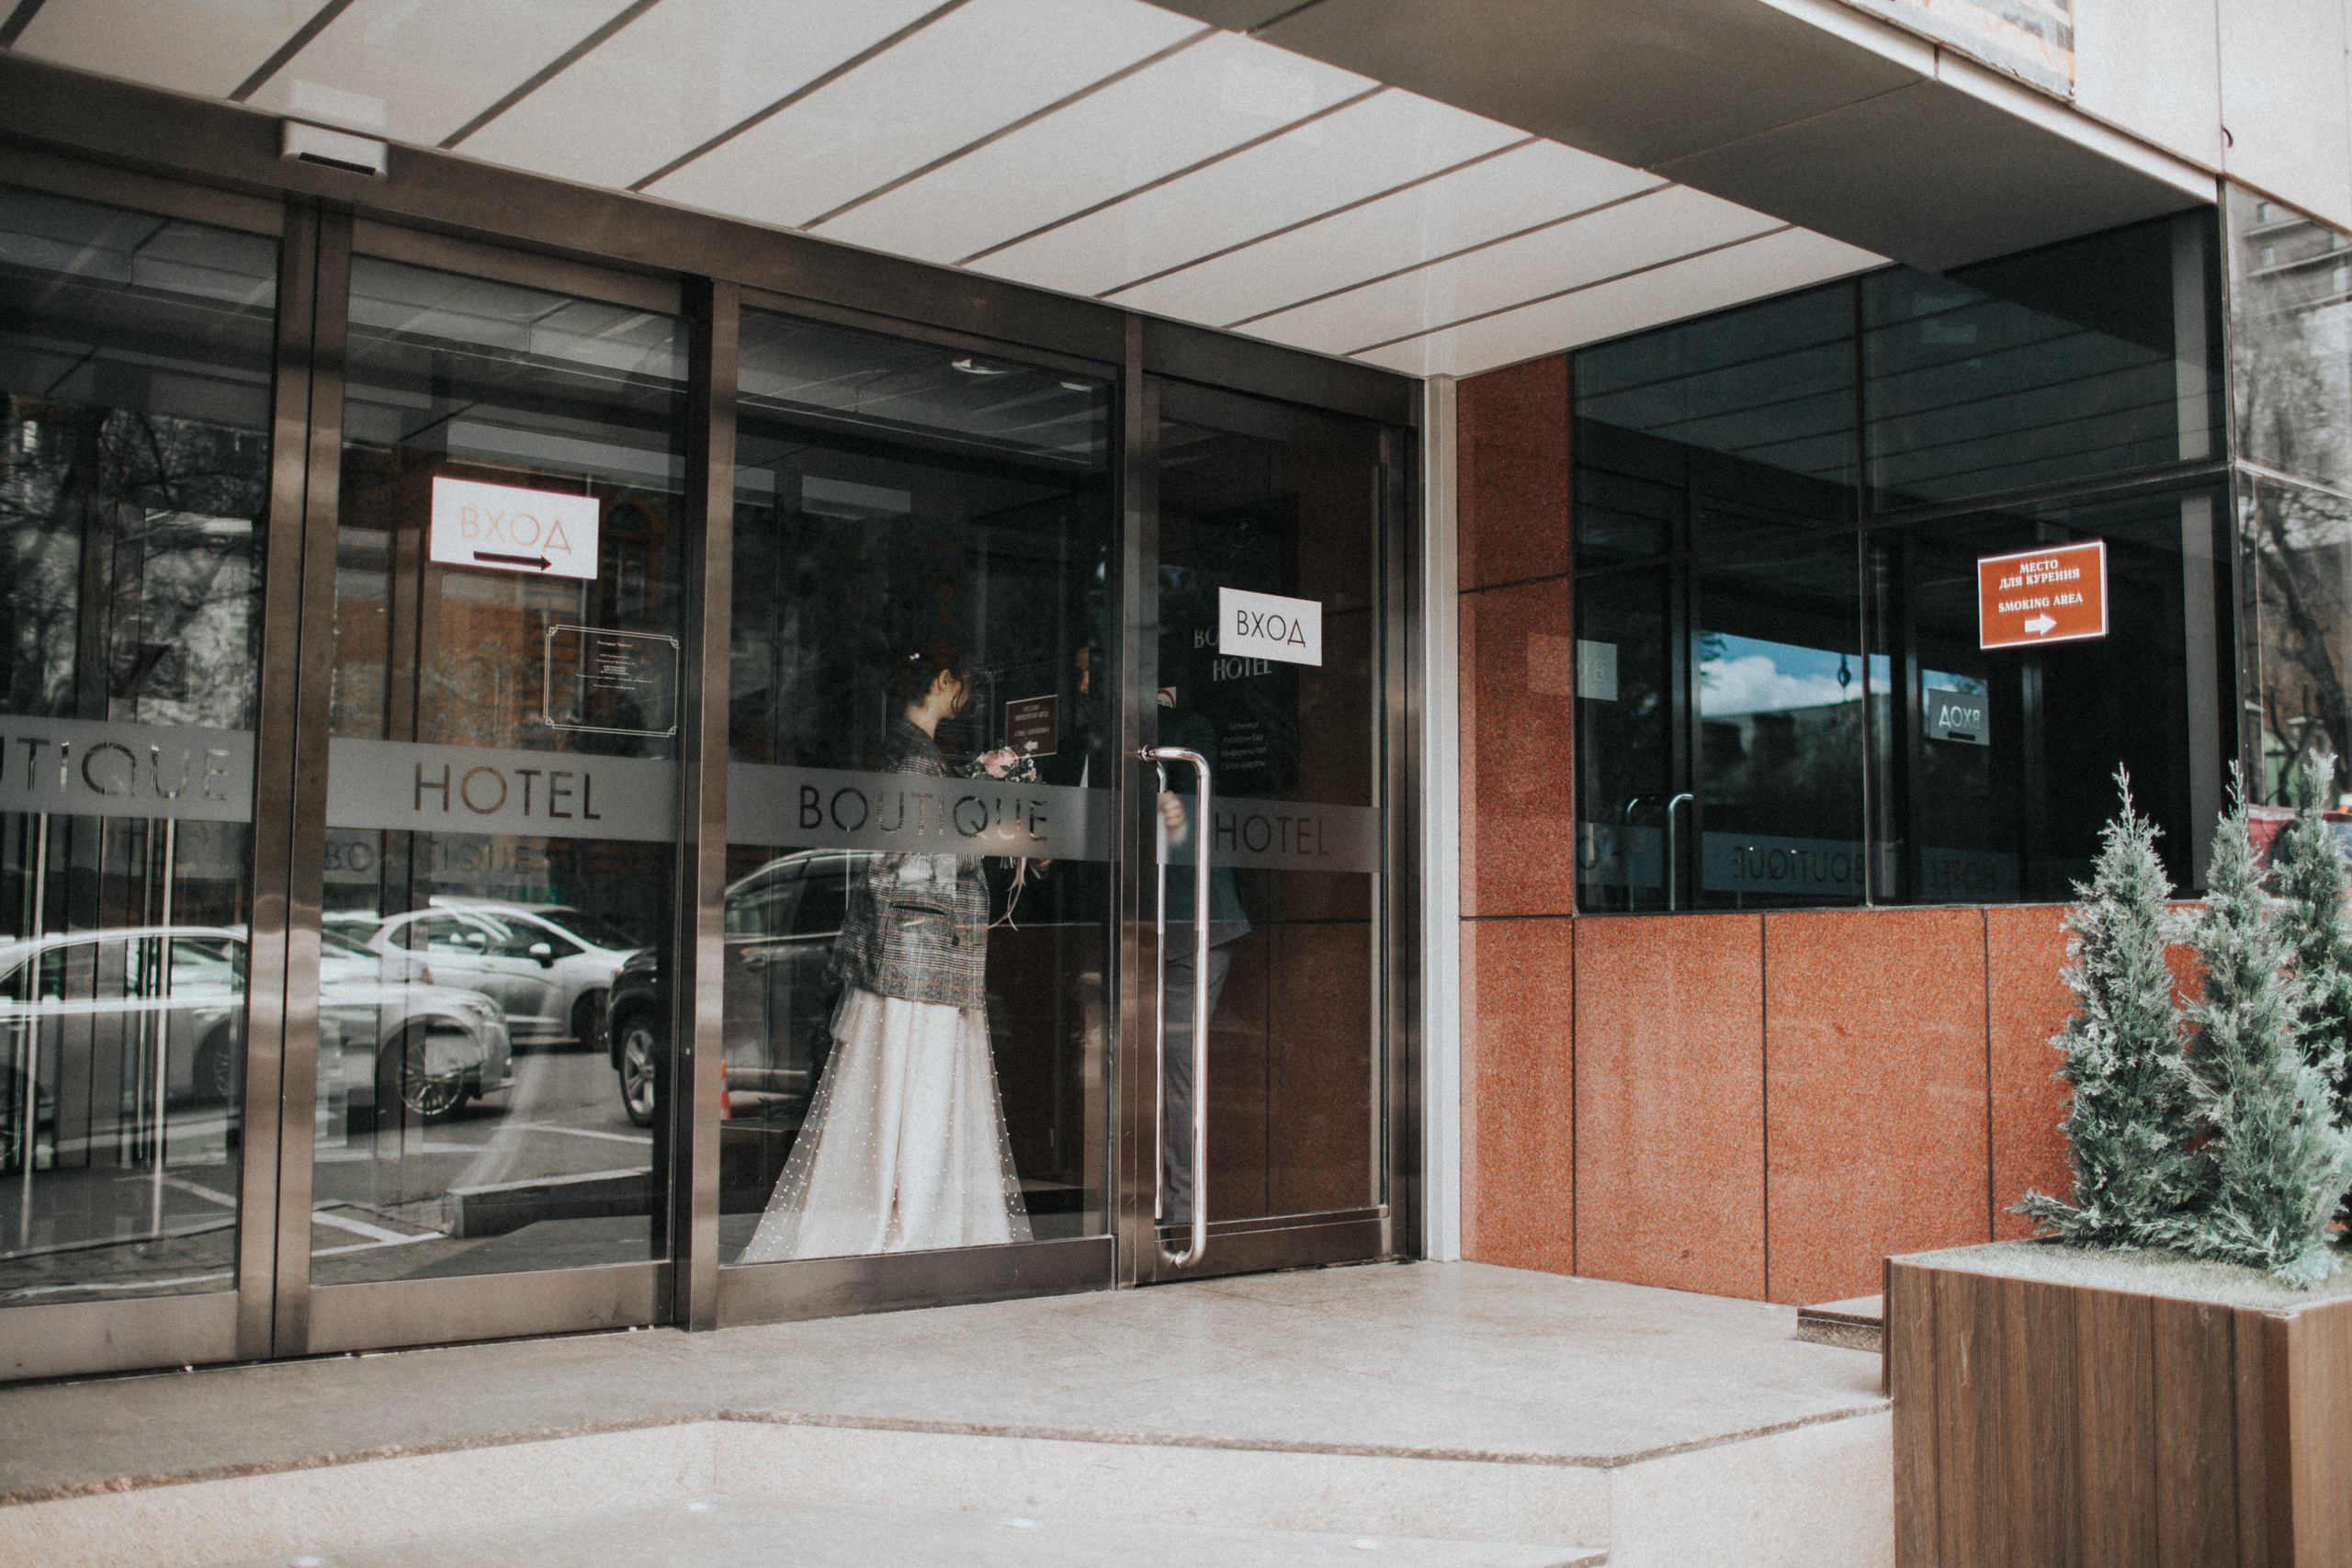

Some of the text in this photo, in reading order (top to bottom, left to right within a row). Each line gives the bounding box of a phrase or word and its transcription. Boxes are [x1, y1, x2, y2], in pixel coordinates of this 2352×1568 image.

[460, 506, 571, 555] ВХОД
[1999, 569, 2080, 590] ДЛЯ КУРЕНИЯ
[2019, 559, 2058, 573] МЕСТО
[1998, 593, 2083, 613] SMOKING AREA
[1237, 610, 1306, 648] ВХОД
[1213, 658, 1272, 682] HOTEL
[0, 737, 231, 801] TIQUE
[414, 762, 601, 820] HOTEL
[799, 784, 1048, 841] BOUTIQUE
[1216, 812, 1329, 856] HOTEL
